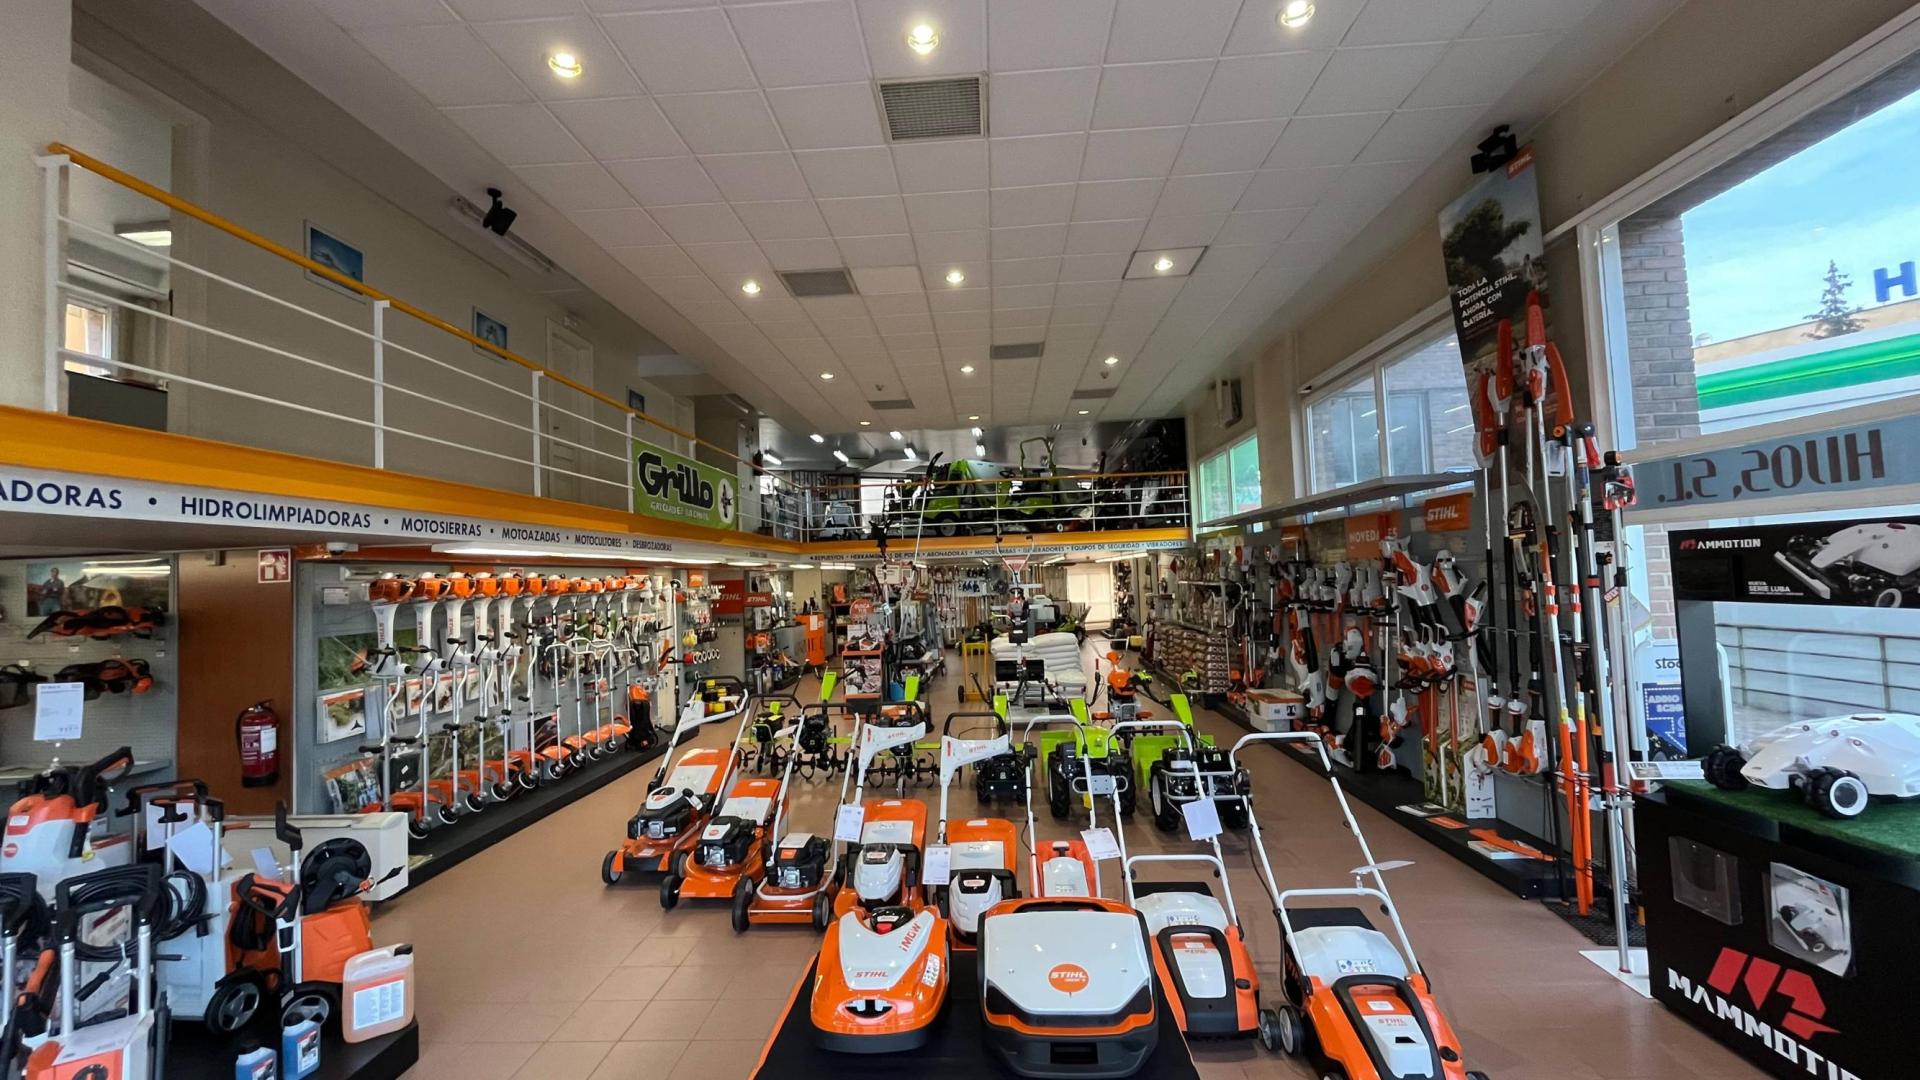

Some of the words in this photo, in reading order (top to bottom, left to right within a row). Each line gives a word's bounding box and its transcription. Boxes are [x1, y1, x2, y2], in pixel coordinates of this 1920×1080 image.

[1457, 282, 1477, 298] TODA
[1477, 276, 1488, 288] LA
[1459, 286, 1495, 308] POTENCIA
[1461, 301, 1486, 318] AHORA
[1487, 291, 1502, 304] CON
[638, 450, 715, 510] Grillo
[181, 496, 371, 529] HIDROLIMPIADORAS
[401, 517, 482, 537] MOTOSIERRAS
[501, 527, 561, 543] MOTOAZADAS
[574, 534, 622, 548] MOTOCULTORES
[1427, 505, 1459, 521] STIHL
[1108, 542, 1140, 550] SEGURIDAD
[1146, 541, 1183, 549] VIBRADORES
[855, 970, 889, 978] STIHL
[1050, 971, 1088, 979] STIHL
